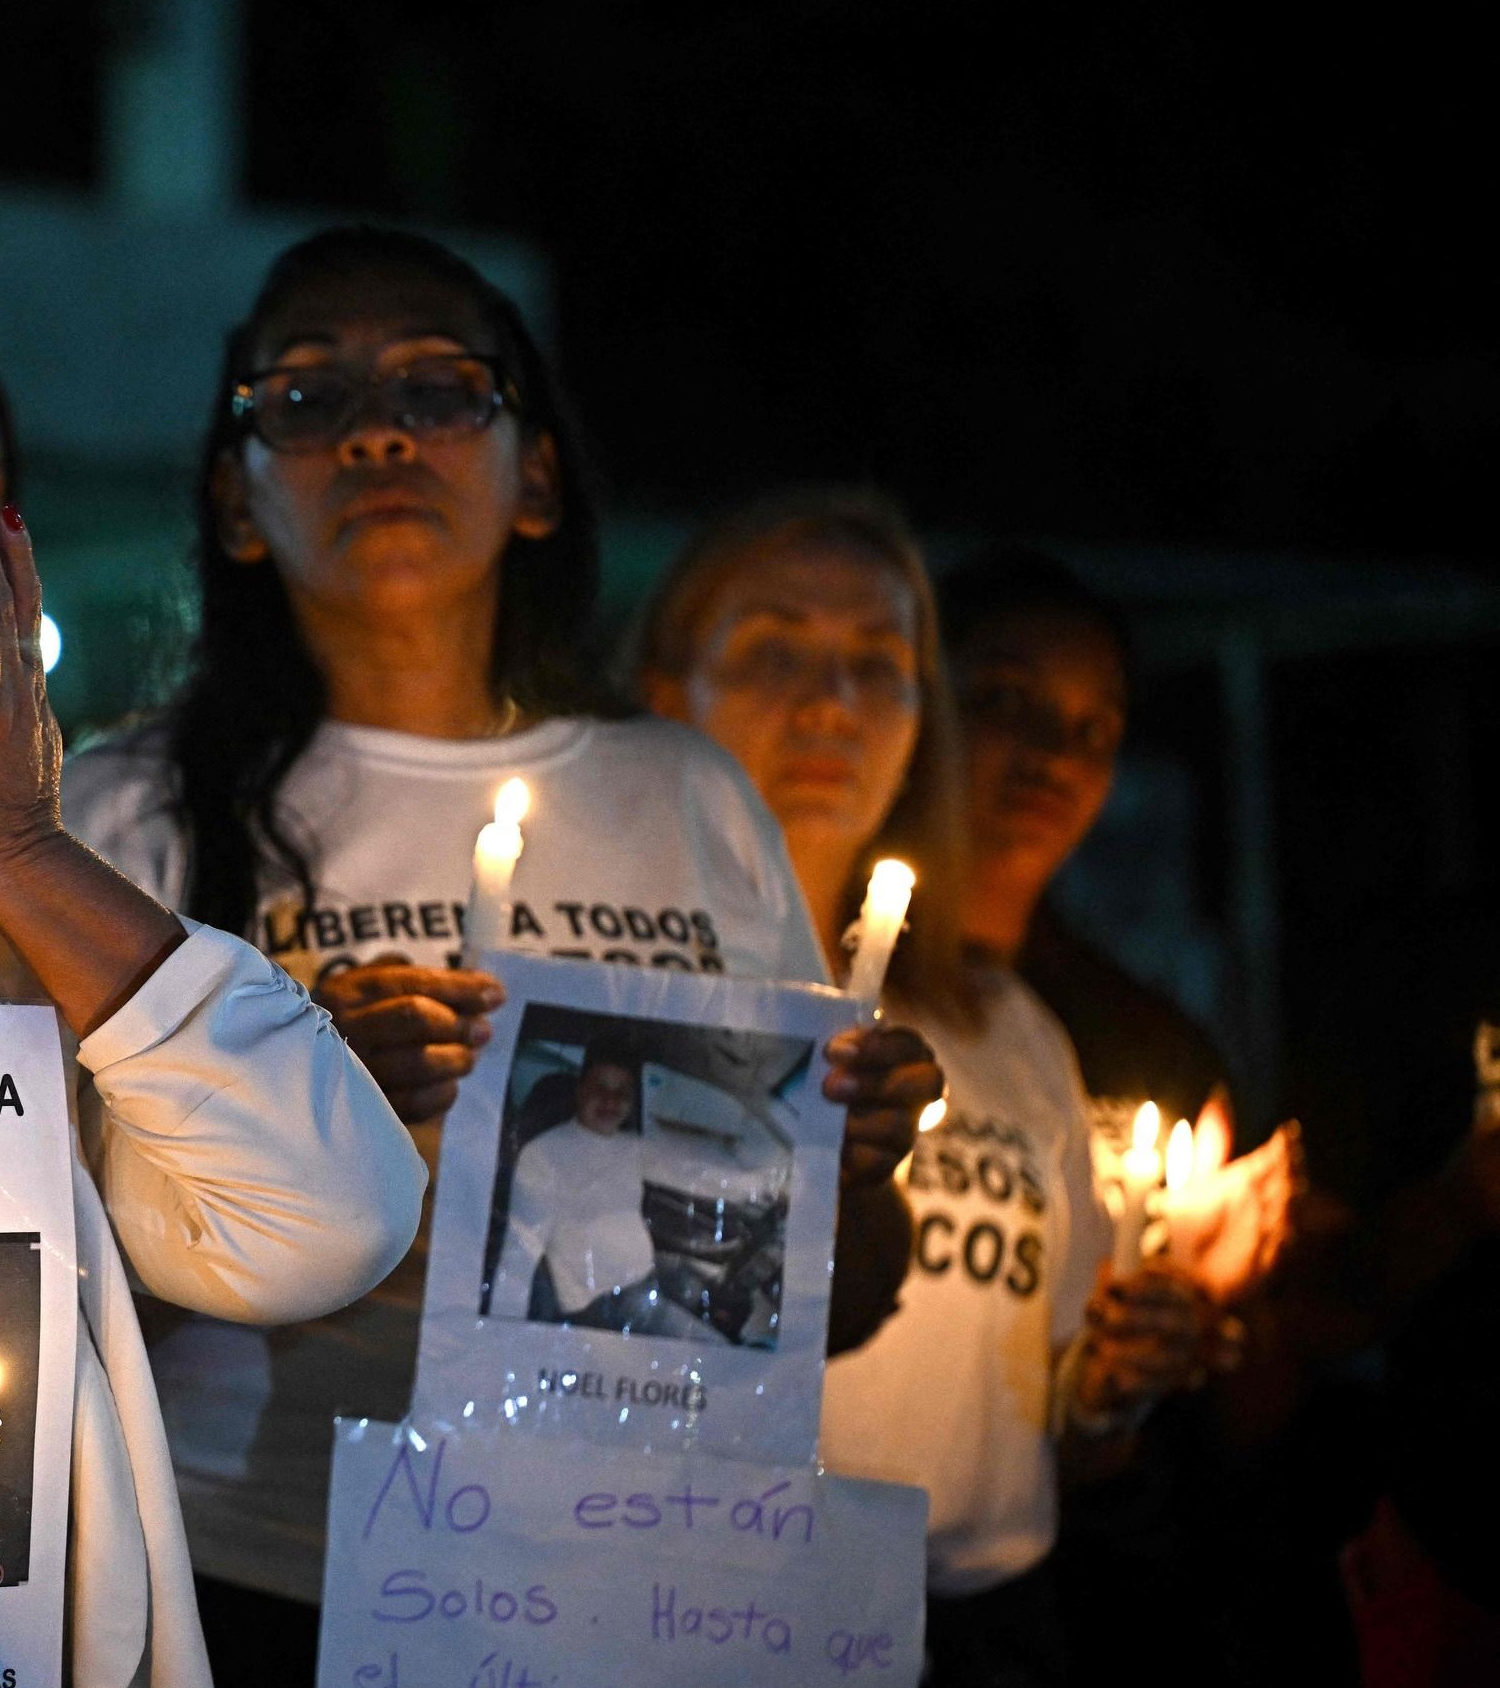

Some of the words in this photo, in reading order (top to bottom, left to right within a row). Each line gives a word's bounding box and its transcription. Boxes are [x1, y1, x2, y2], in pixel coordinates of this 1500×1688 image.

[510, 900, 544, 938] A
[553, 899, 719, 952] TODOS
[537, 1367, 609, 1401] NOEL
[613, 1374, 708, 1412] FLORES
[362, 1437, 491, 1541] No
[573, 1480, 815, 1542] están
[650, 1581, 792, 1654] Hasta
[826, 1628, 894, 1677] que
